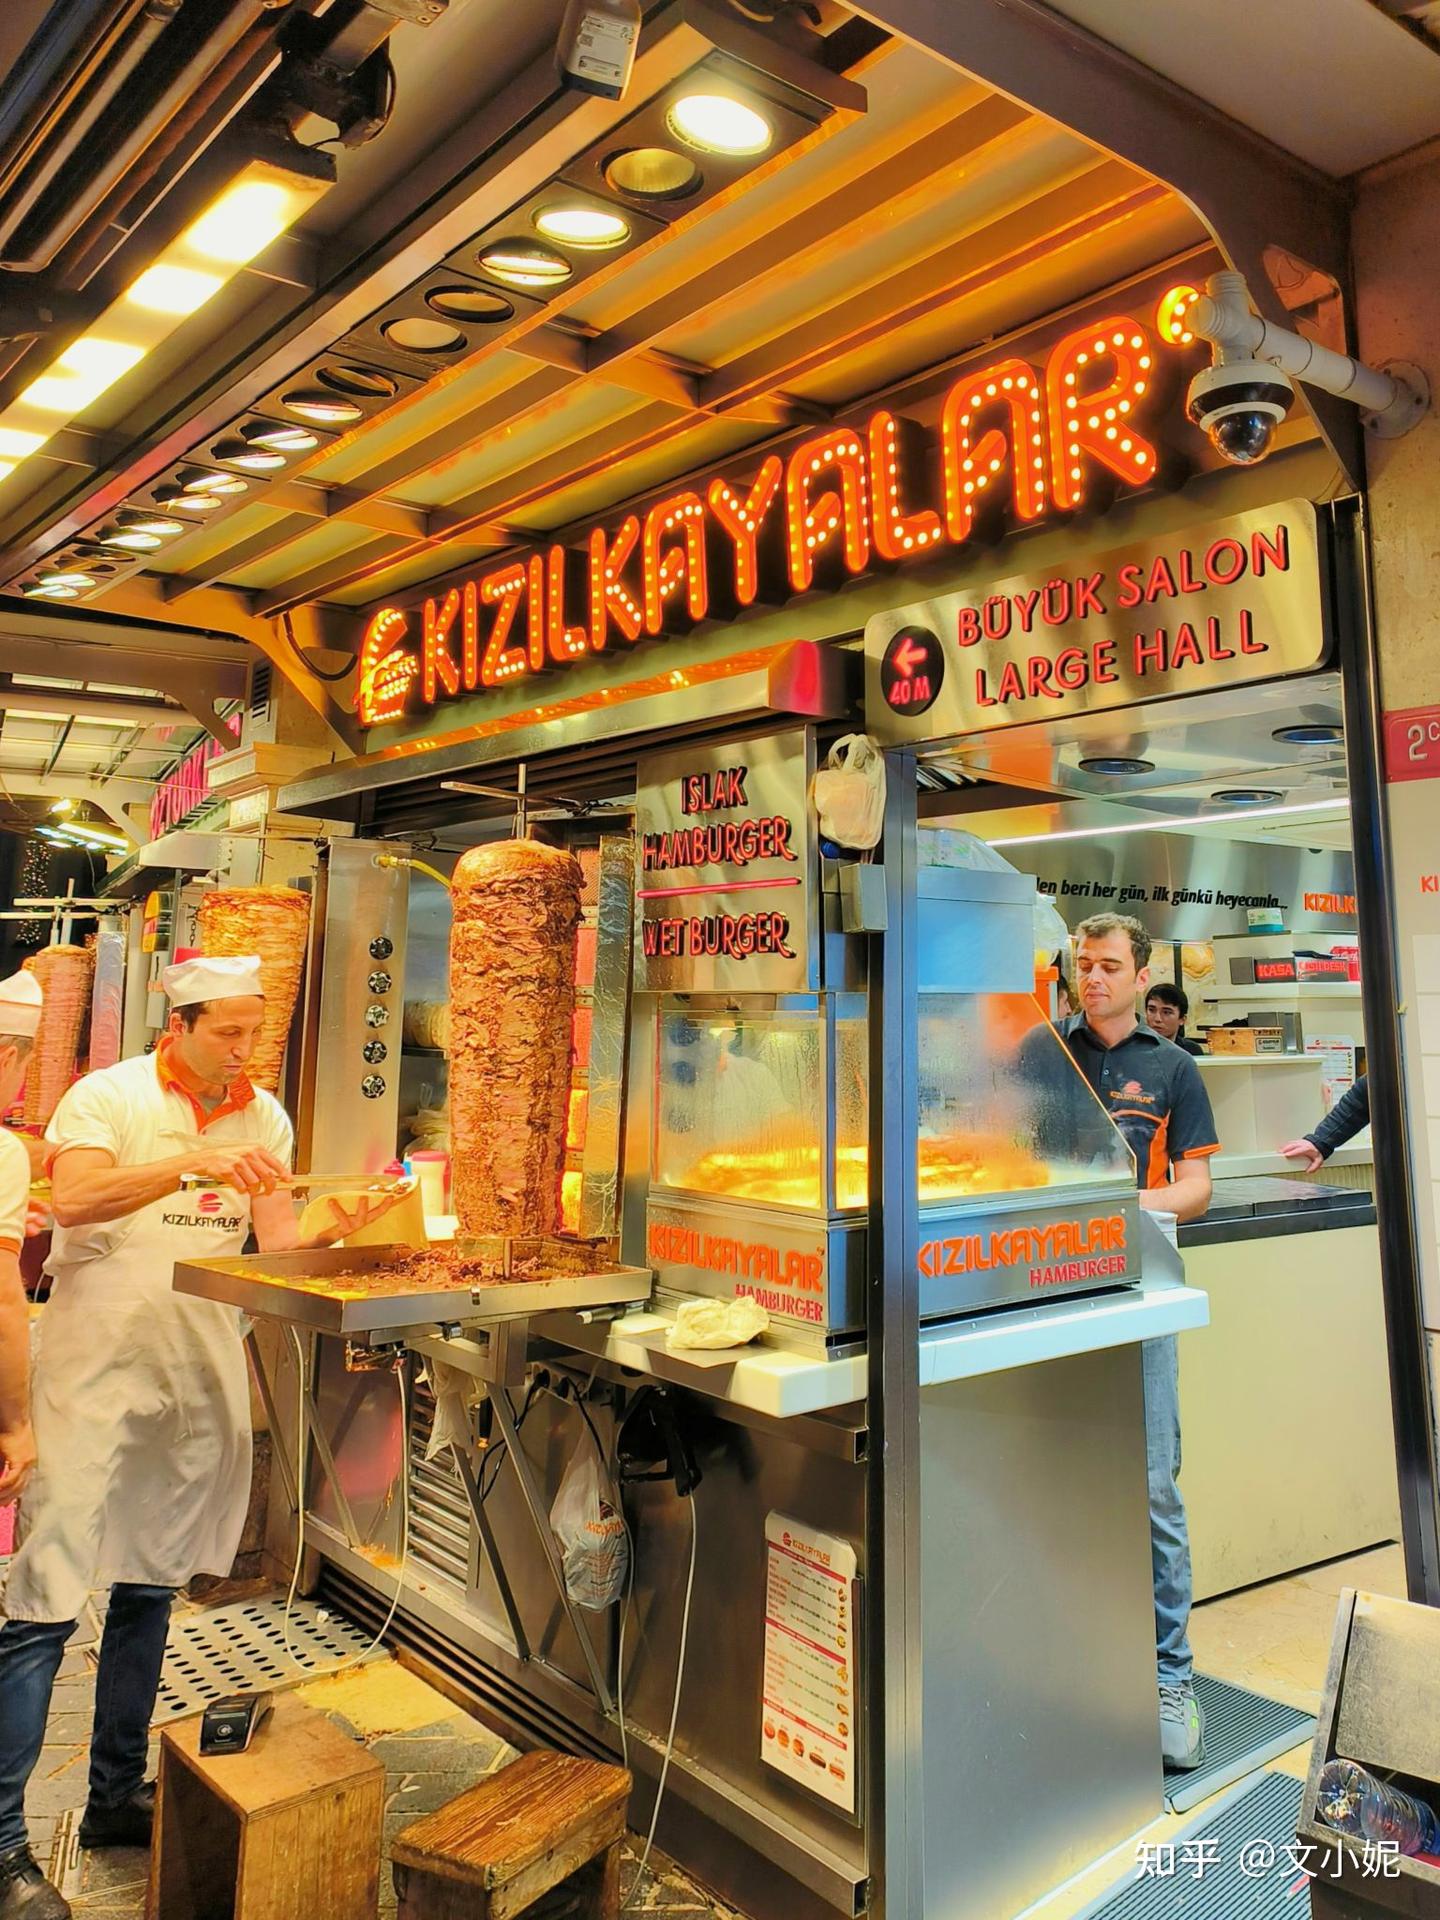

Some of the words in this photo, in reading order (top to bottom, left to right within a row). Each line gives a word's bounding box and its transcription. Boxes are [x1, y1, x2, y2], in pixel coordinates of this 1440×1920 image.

[421, 314, 1157, 704] KIZILKAYALAR
[958, 572, 1106, 647] BÜYÜK
[1118, 524, 1289, 608] SALON
[975, 640, 1118, 707] LARGE
[1134, 609, 1269, 675] HALL
[889, 679, 911, 704] 40
[914, 675, 931, 701] M
[681, 765, 748, 815] ISLAK
[642, 815, 798, 871] HAMBURGER
[1061, 880, 1090, 896] beri
[1093, 882, 1117, 897] her
[1119, 884, 1148, 903] gün,
[1153, 886, 1169, 901] ilk
[1172, 888, 1213, 906] günkü
[1304, 892, 1357, 914] KIZILK
[642, 918, 688, 957] WET
[690, 911, 797, 960] BURGER
[1258, 963, 1294, 977] KASA
[649, 1223, 823, 1293] KIZILKAYALAR
[1030, 1256, 1126, 1288] HAMBURGER
